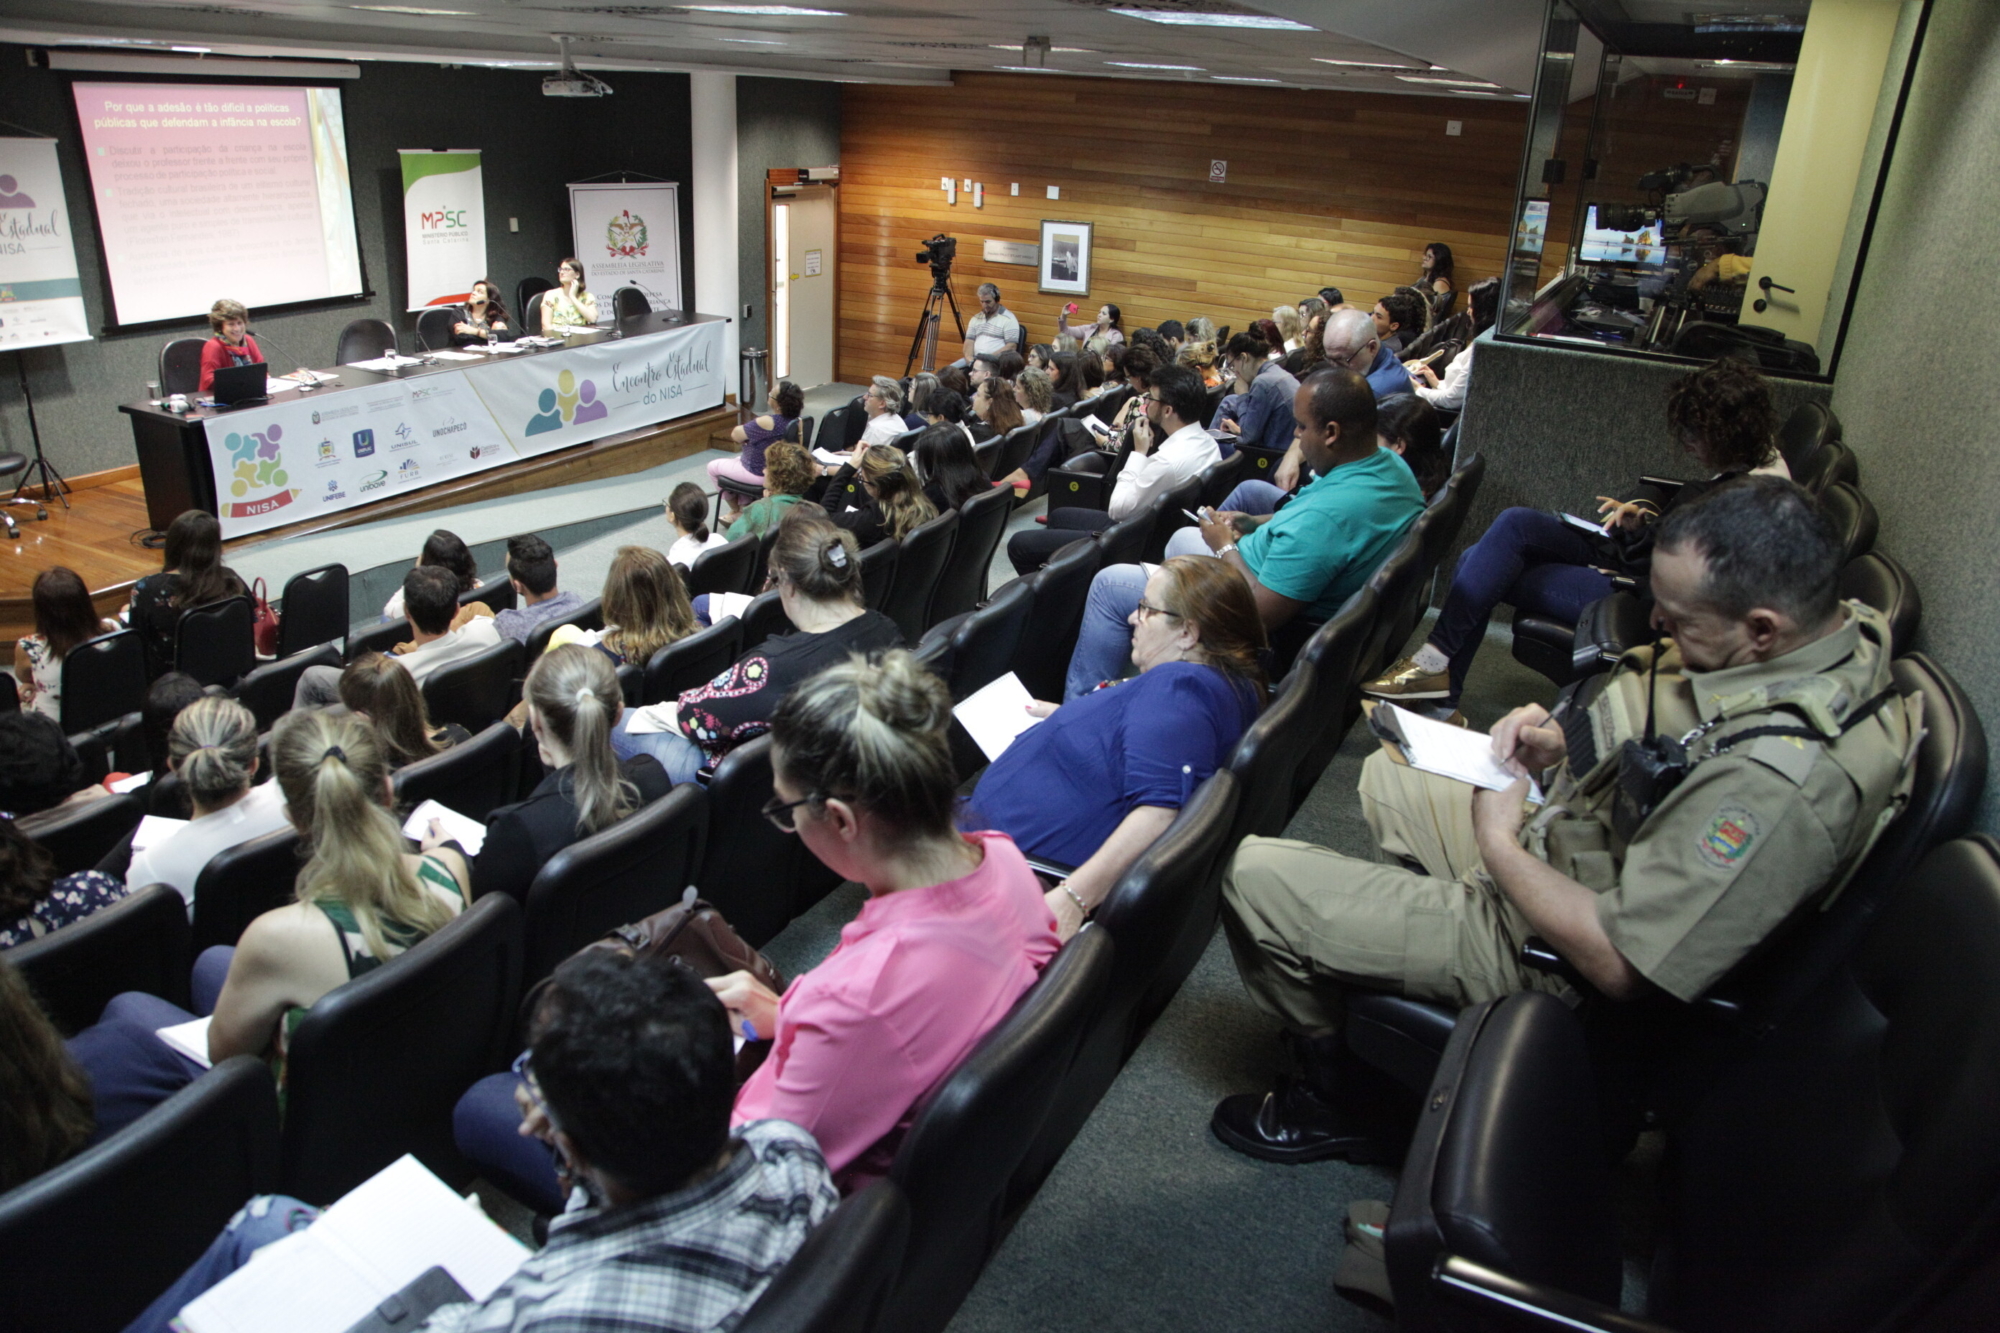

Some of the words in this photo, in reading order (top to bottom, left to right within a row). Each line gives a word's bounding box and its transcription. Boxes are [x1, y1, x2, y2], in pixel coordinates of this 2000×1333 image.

[104, 100, 122, 112] Por
[126, 103, 144, 114] que
[148, 104, 154, 112] a
[157, 102, 192, 112] adesão
[195, 102, 201, 112] é
[204, 102, 219, 112] tão
[247, 104, 253, 113] a
[94, 117, 137, 130] públicas
[140, 119, 158, 129] que
[161, 117, 208, 127] defendam
[211, 119, 218, 127] a
[220, 117, 254, 127] infância
[270, 117, 302, 126] escola?
[219, 144, 229, 153] da
[234, 144, 262, 154] criança
[283, 143, 307, 151] escola
[111, 158, 141, 169] deixou
[144, 160, 150, 168] o
[152, 157, 191, 168] professor
[192, 156, 216, 166] frente
[225, 155, 248, 165] frente
[250, 156, 266, 164] com
[268, 155, 282, 163] seu
[114, 172, 155, 182] processo
[156, 170, 167, 179] de
[421, 210, 467, 230] MPSC
[628, 260, 665, 268] LEGISLATIVA
[612, 361, 662, 394] Encontro
[665, 340, 712, 382] Estadual
[642, 391, 657, 406] do
[659, 384, 683, 402] NISA
[390, 440, 418, 449] UNISUL
[399, 470, 419, 480] FURB
[322, 491, 346, 502] UNIFEBE
[246, 500, 279, 515] NISA
